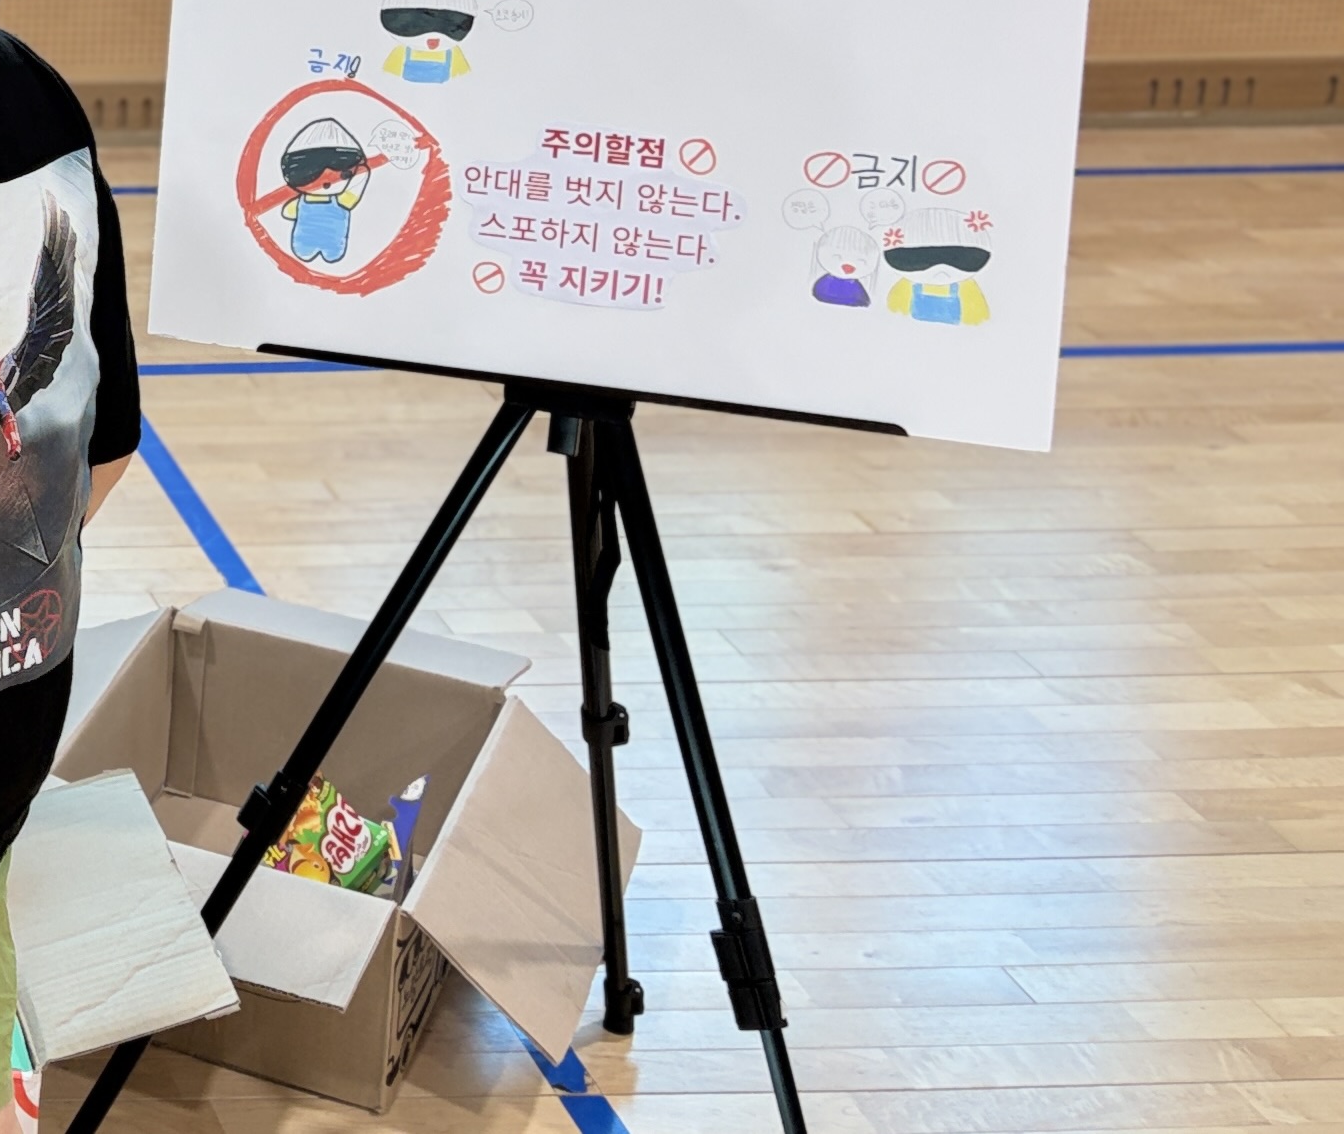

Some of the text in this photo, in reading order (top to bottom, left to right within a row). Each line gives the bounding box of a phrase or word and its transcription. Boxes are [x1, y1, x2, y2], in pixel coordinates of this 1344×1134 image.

[541, 128, 666, 169] 주의할점
[464, 165, 741, 222] 안대를 벗지 않는다.
[850, 153, 917, 192] 금지
[478, 213, 715, 266] 스포하지 않는다.
[518, 260, 664, 305] 꼭 지키기!
